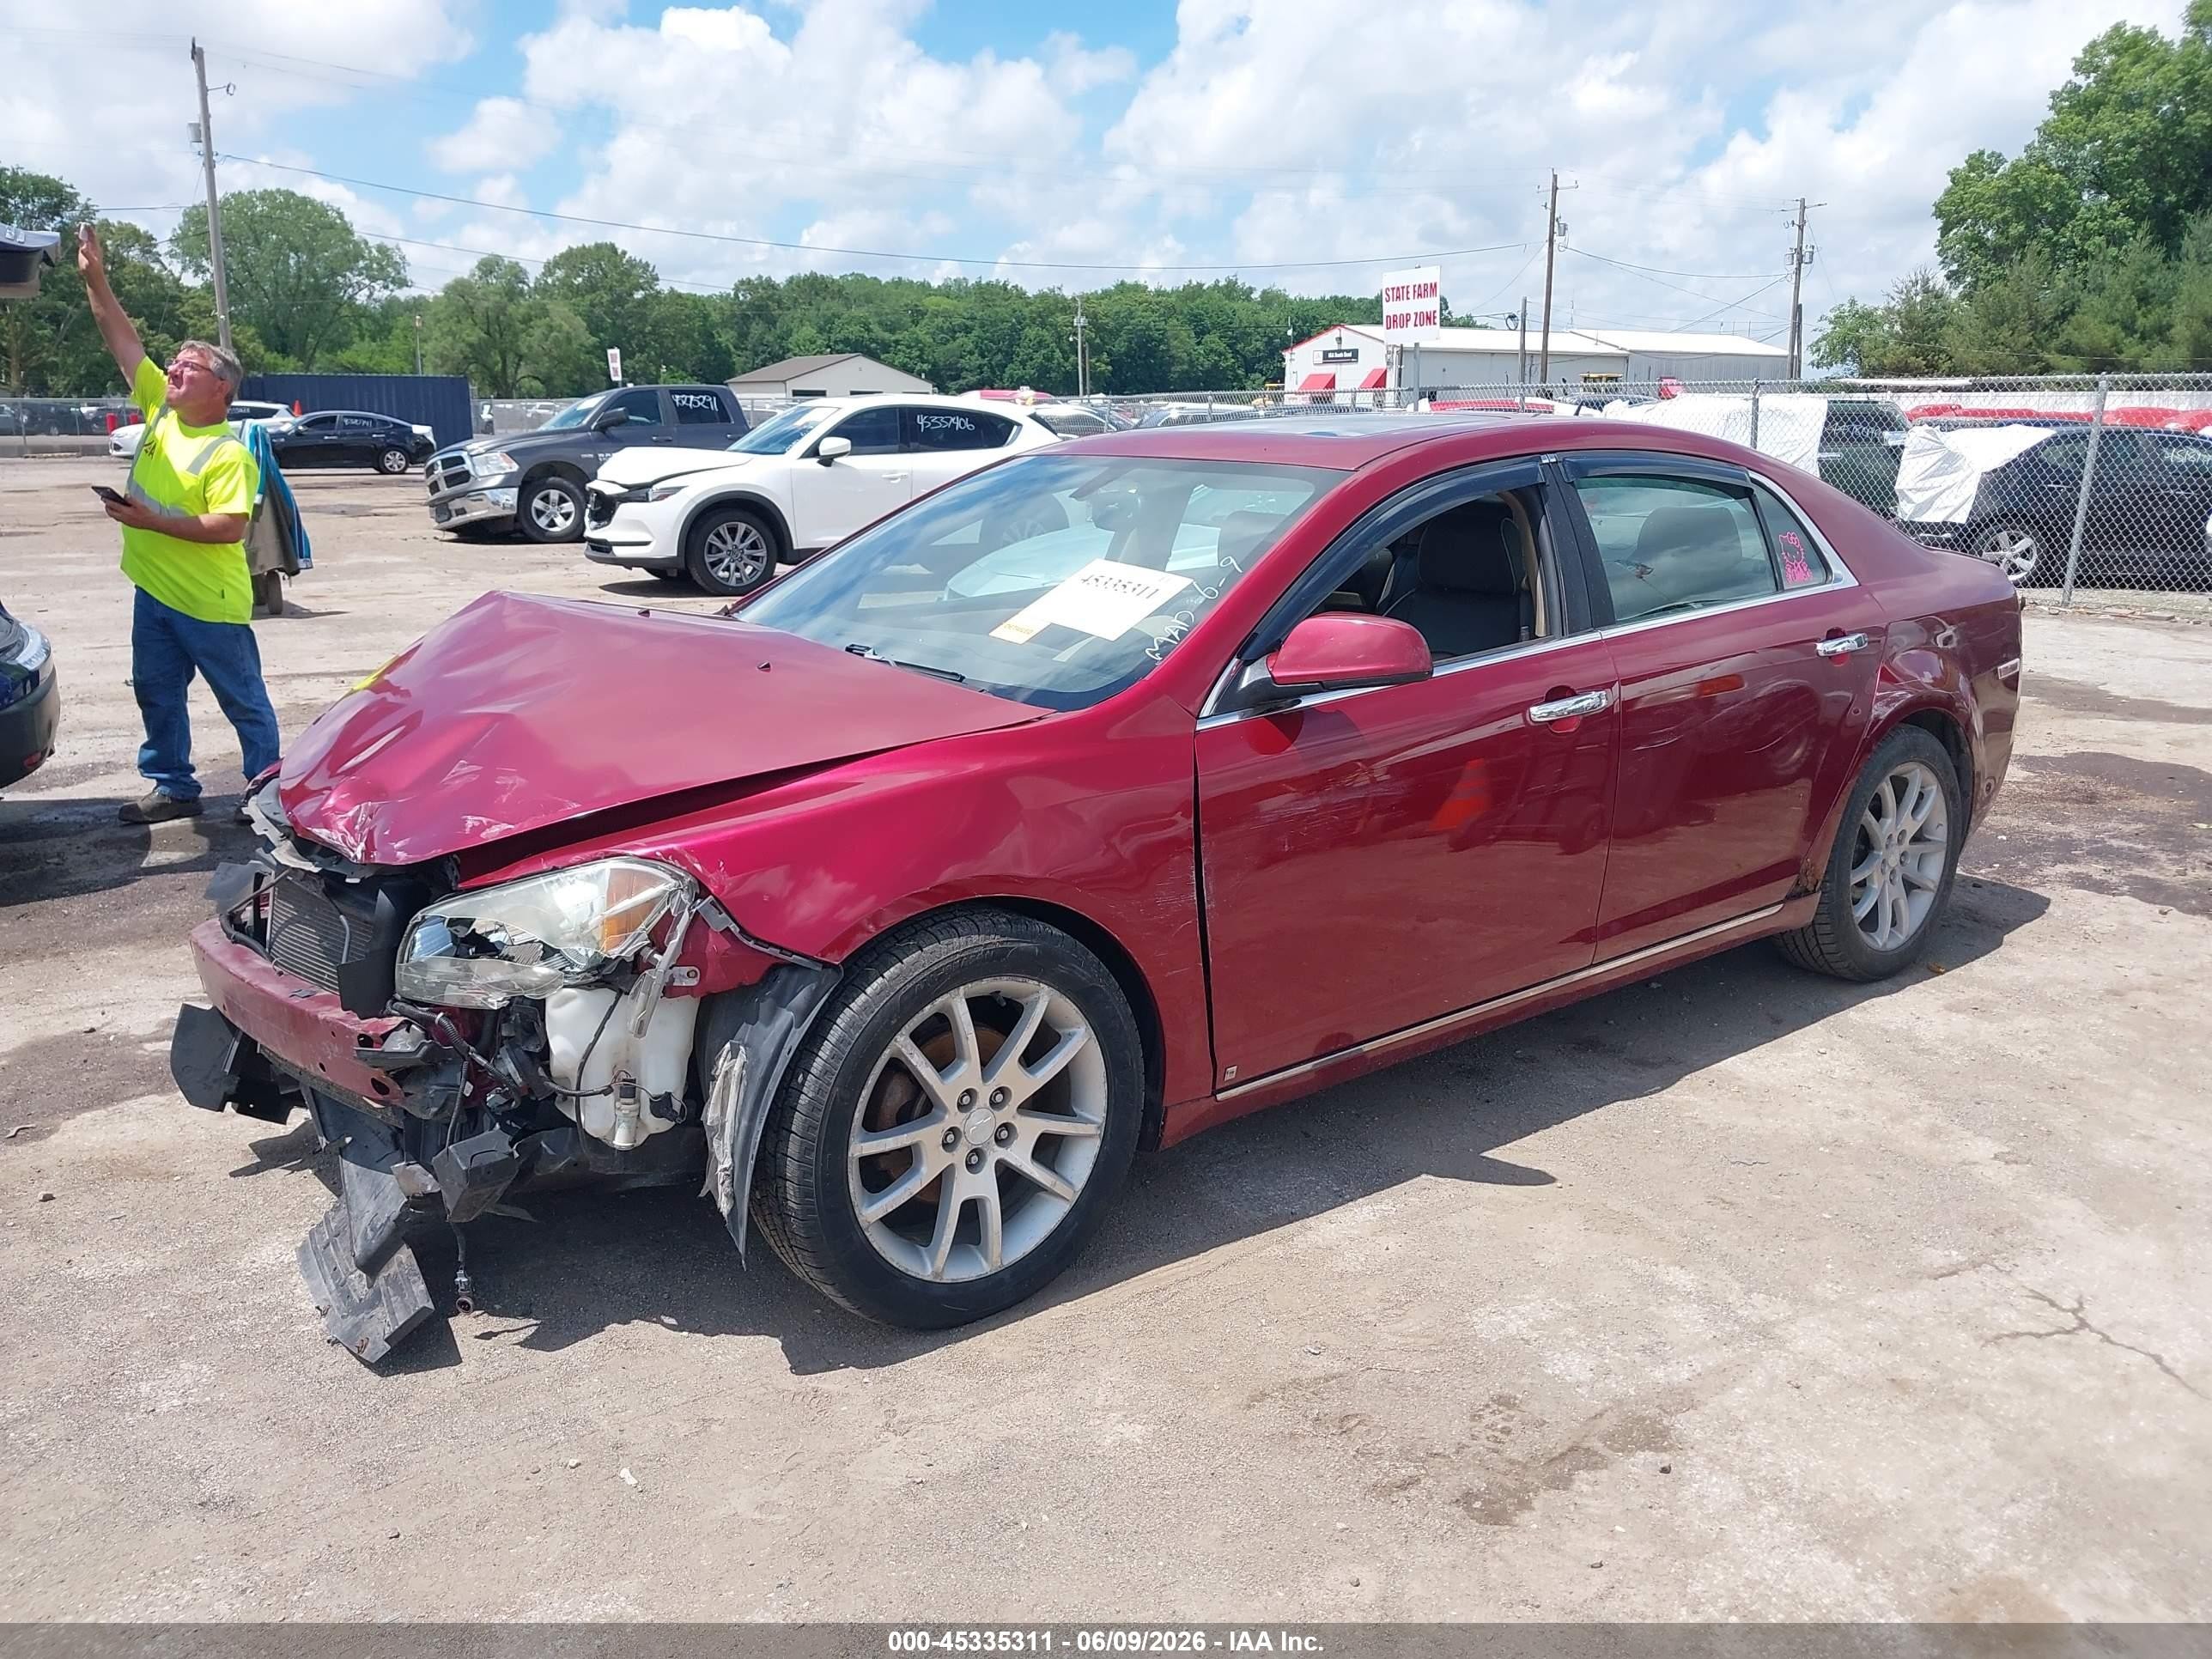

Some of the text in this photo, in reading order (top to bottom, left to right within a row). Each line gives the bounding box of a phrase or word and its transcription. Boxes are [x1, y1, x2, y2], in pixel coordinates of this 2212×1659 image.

[1385, 282, 1437, 303] STATE FARM
[1386, 310, 1437, 330] DROP ZONE
[916, 414, 975, 433] 45337406
[1145, 556, 1243, 665] MAD 6-9
